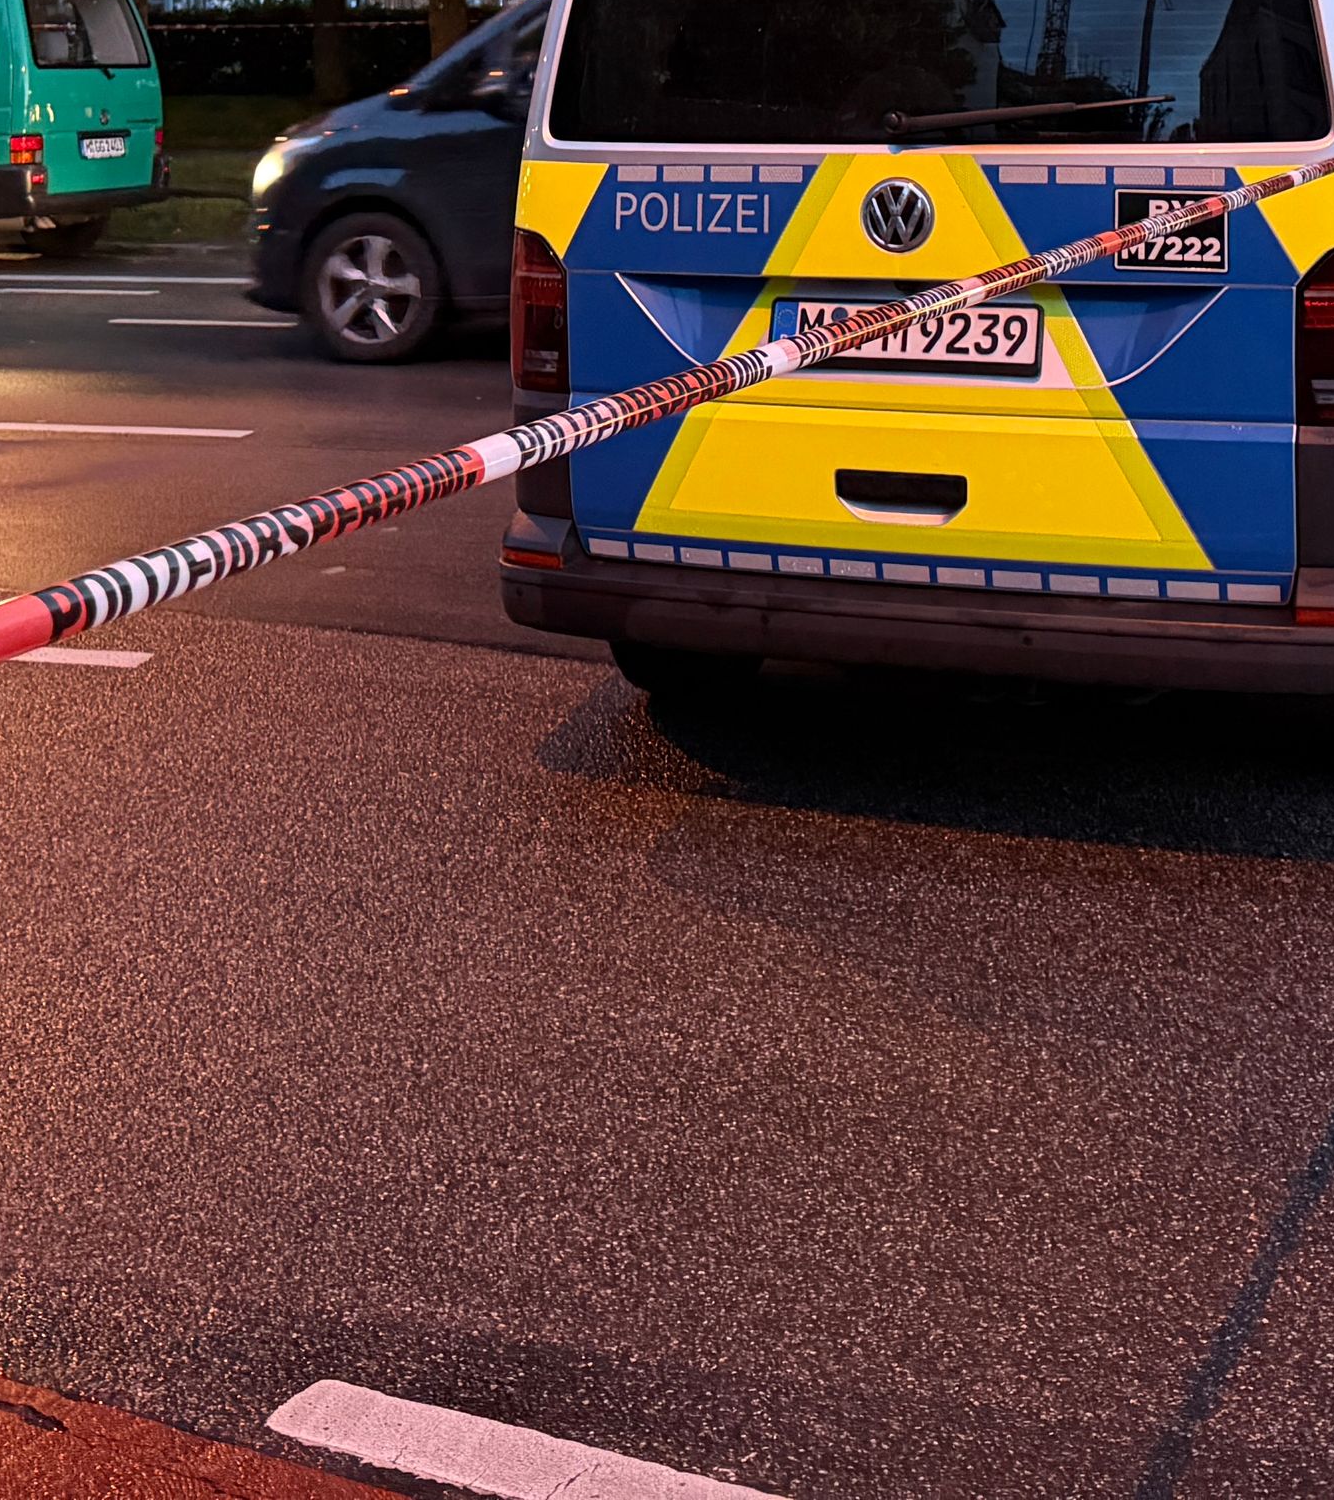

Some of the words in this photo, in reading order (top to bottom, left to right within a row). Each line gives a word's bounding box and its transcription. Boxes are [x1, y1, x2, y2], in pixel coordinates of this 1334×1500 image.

[615, 191, 769, 234] POLIZEI
[1121, 236, 1221, 262] M7222
[920, 313, 1028, 357] 9239
